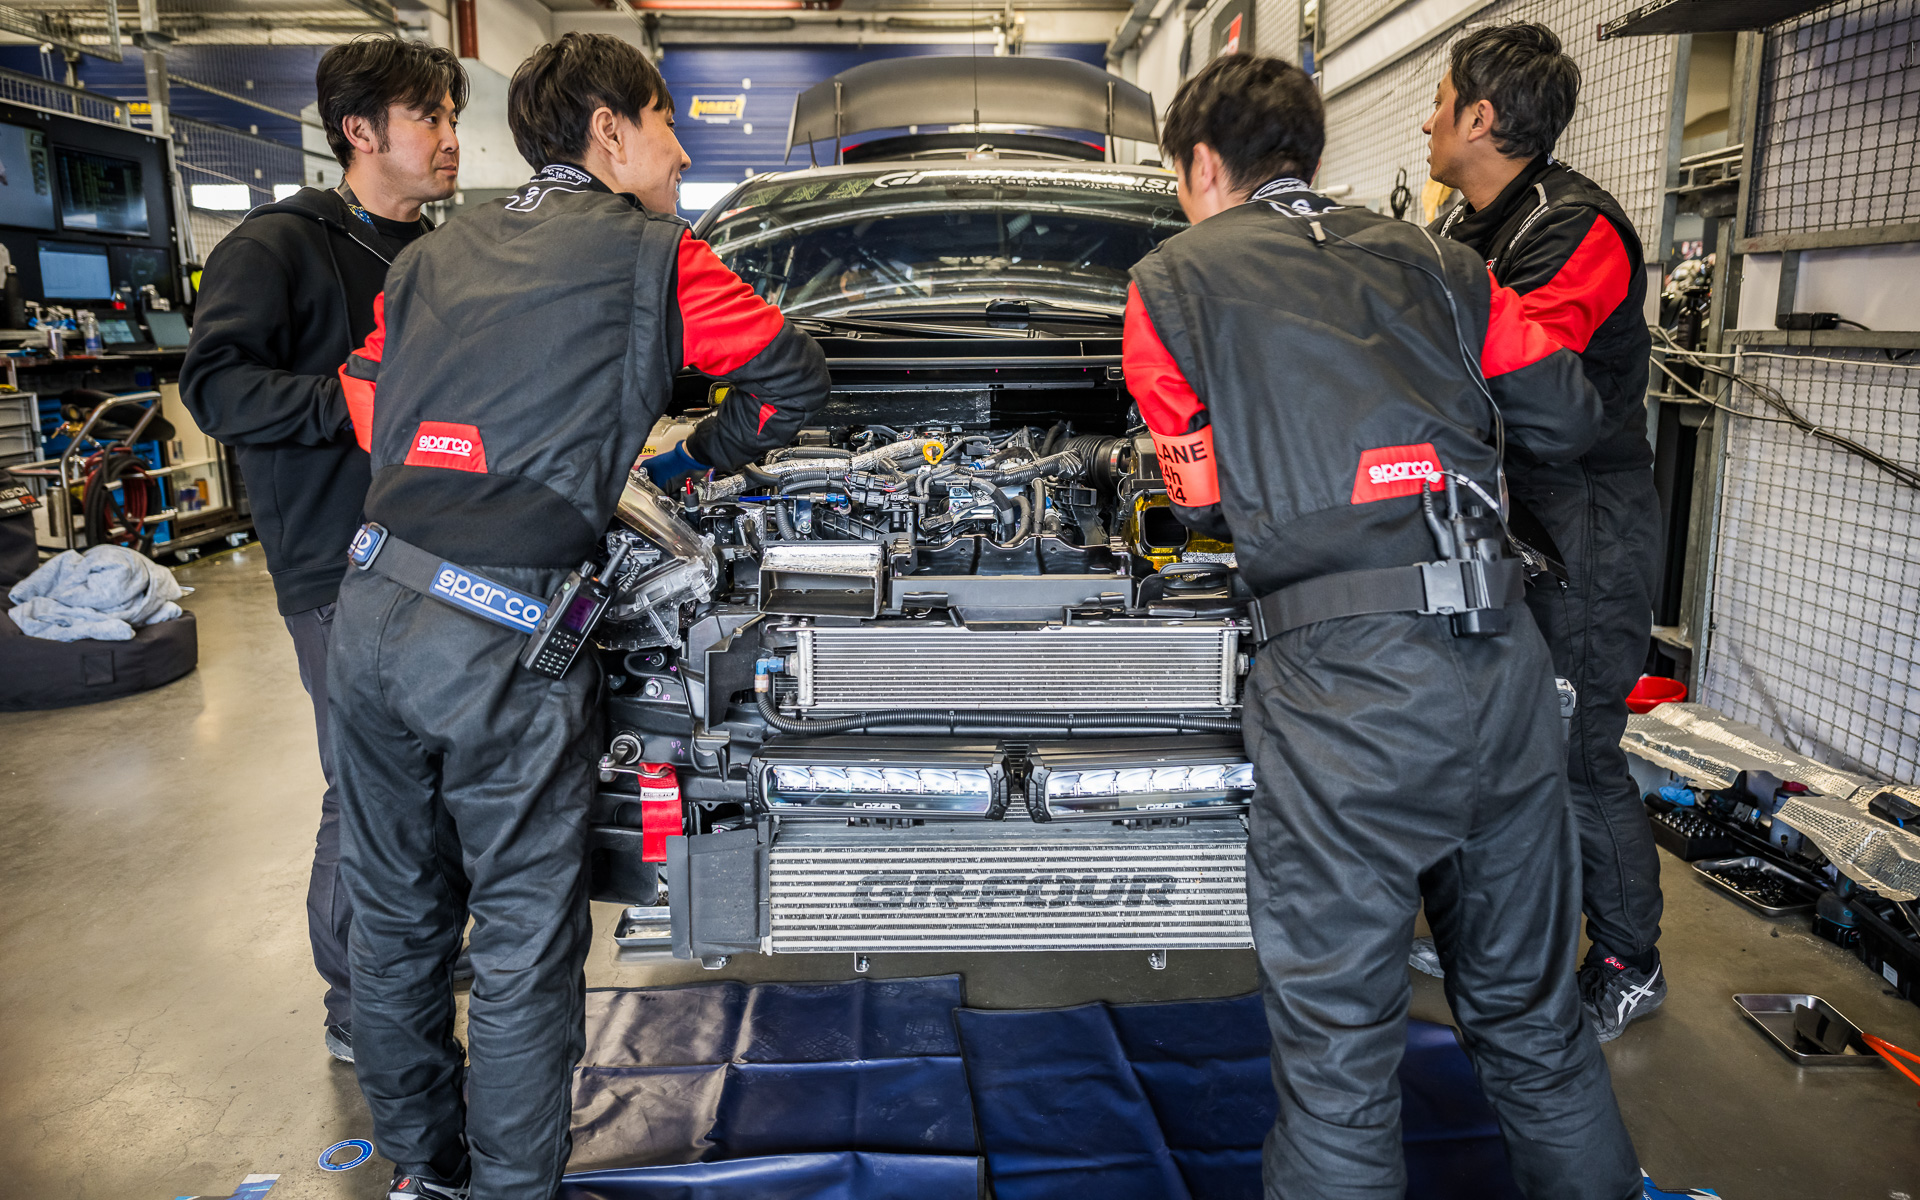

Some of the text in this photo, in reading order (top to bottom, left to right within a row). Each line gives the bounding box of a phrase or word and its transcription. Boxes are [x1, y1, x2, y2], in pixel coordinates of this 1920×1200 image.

[1005, 179, 1048, 187] REAL
[1053, 180, 1121, 190] DRIVING
[1124, 186, 1178, 196] SIMUL
[417, 435, 473, 456] sparco
[1159, 440, 1208, 463] ANE
[1161, 464, 1183, 486] 4h
[1368, 460, 1434, 483] sparco
[436, 569, 542, 626] sparco
[852, 874, 1178, 911] GR-FOUR
